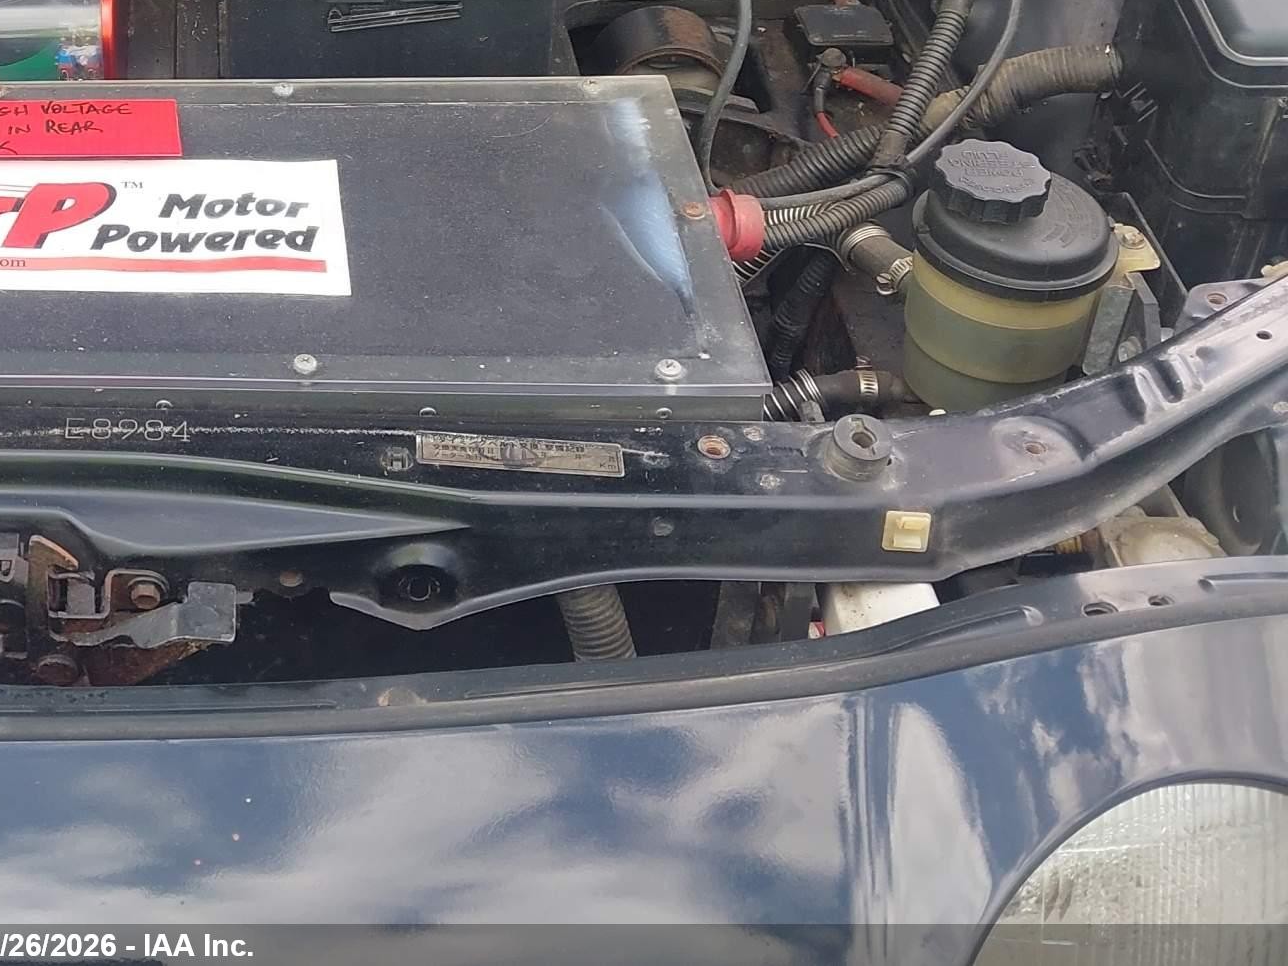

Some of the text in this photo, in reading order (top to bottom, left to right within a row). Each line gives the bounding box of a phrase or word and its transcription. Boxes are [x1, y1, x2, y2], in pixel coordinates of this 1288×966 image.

[40, 101, 134, 116] VOLTAGE
[7, 124, 31, 135] IN
[45, 119, 103, 135] REAR
[158, 191, 310, 221] Motor
[88, 222, 320, 253] Powered
